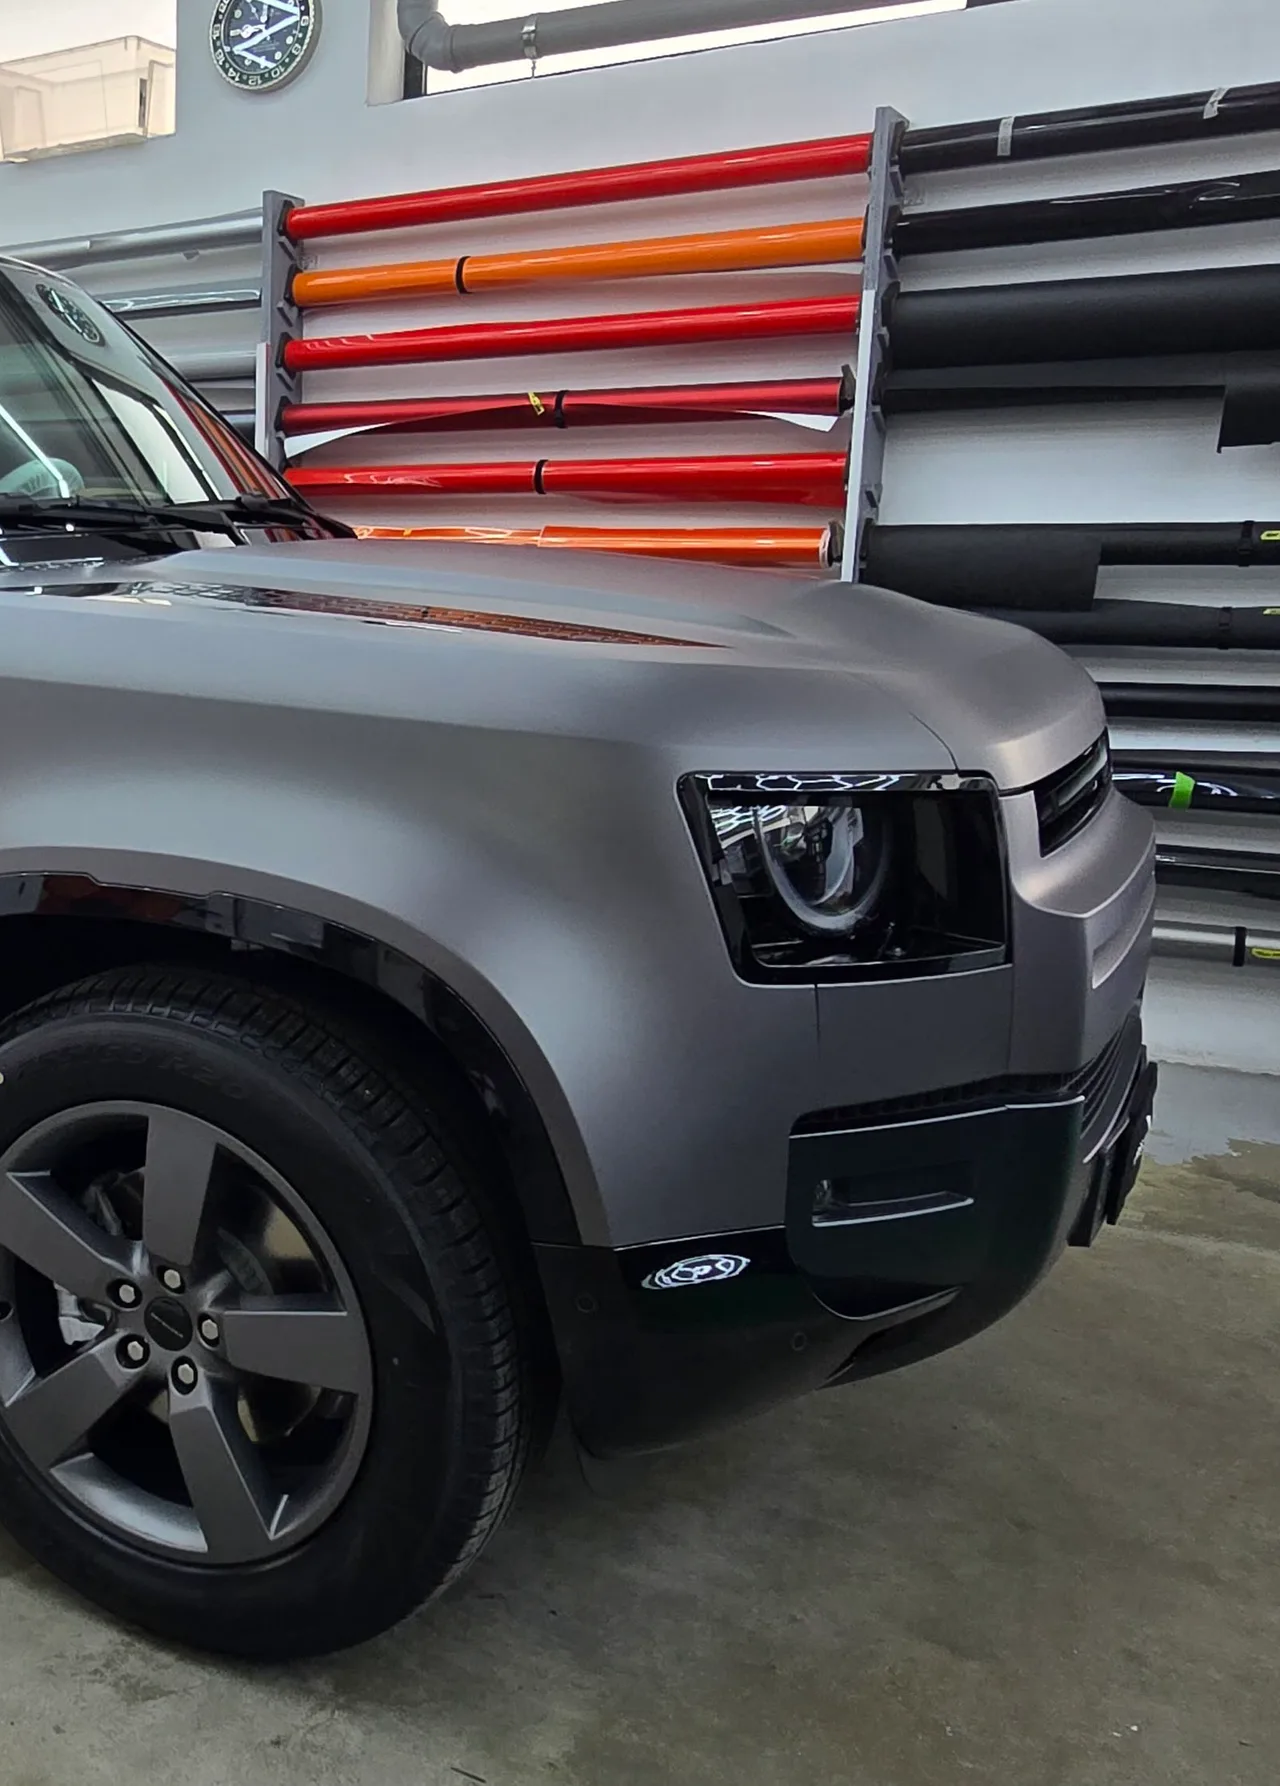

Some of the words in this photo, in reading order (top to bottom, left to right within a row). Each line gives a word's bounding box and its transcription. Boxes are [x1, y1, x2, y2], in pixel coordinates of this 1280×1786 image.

[228, 67, 240, 81] 14
[271, 65, 285, 79] 10
[248, 75, 262, 85] 12
